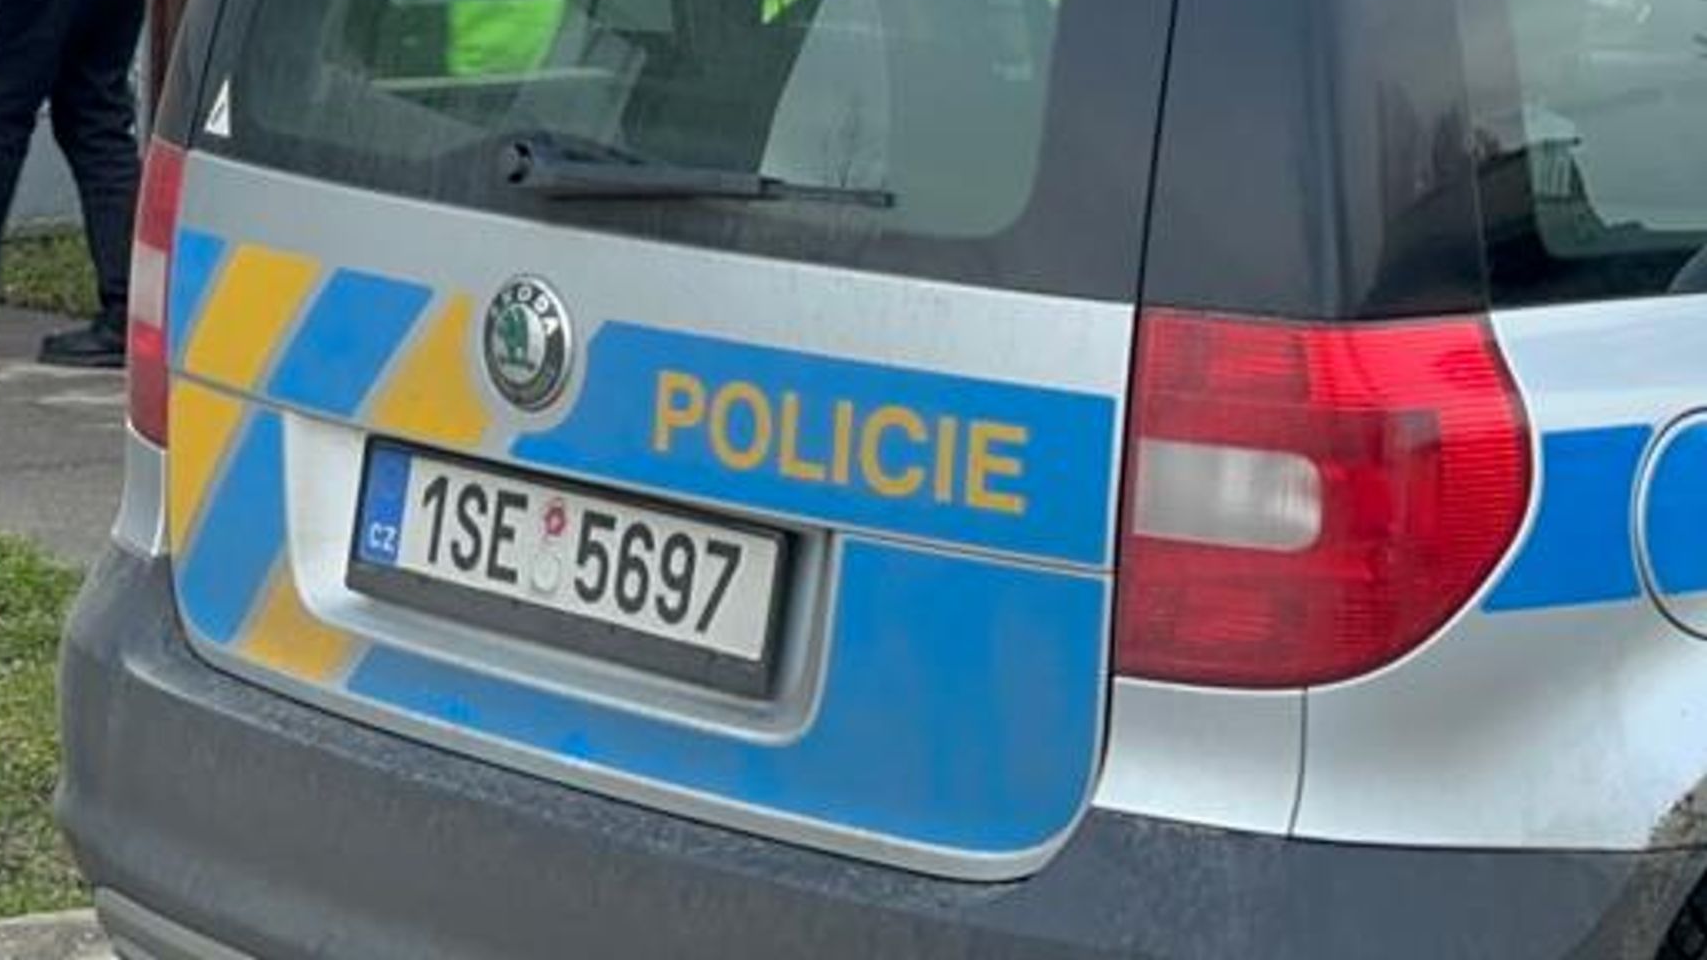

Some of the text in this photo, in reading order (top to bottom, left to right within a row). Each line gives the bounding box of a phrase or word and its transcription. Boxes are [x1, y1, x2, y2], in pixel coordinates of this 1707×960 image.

[652, 369, 1029, 515] POLICIE
[370, 522, 395, 551] CZ
[422, 475, 742, 634] 1SE 5697
